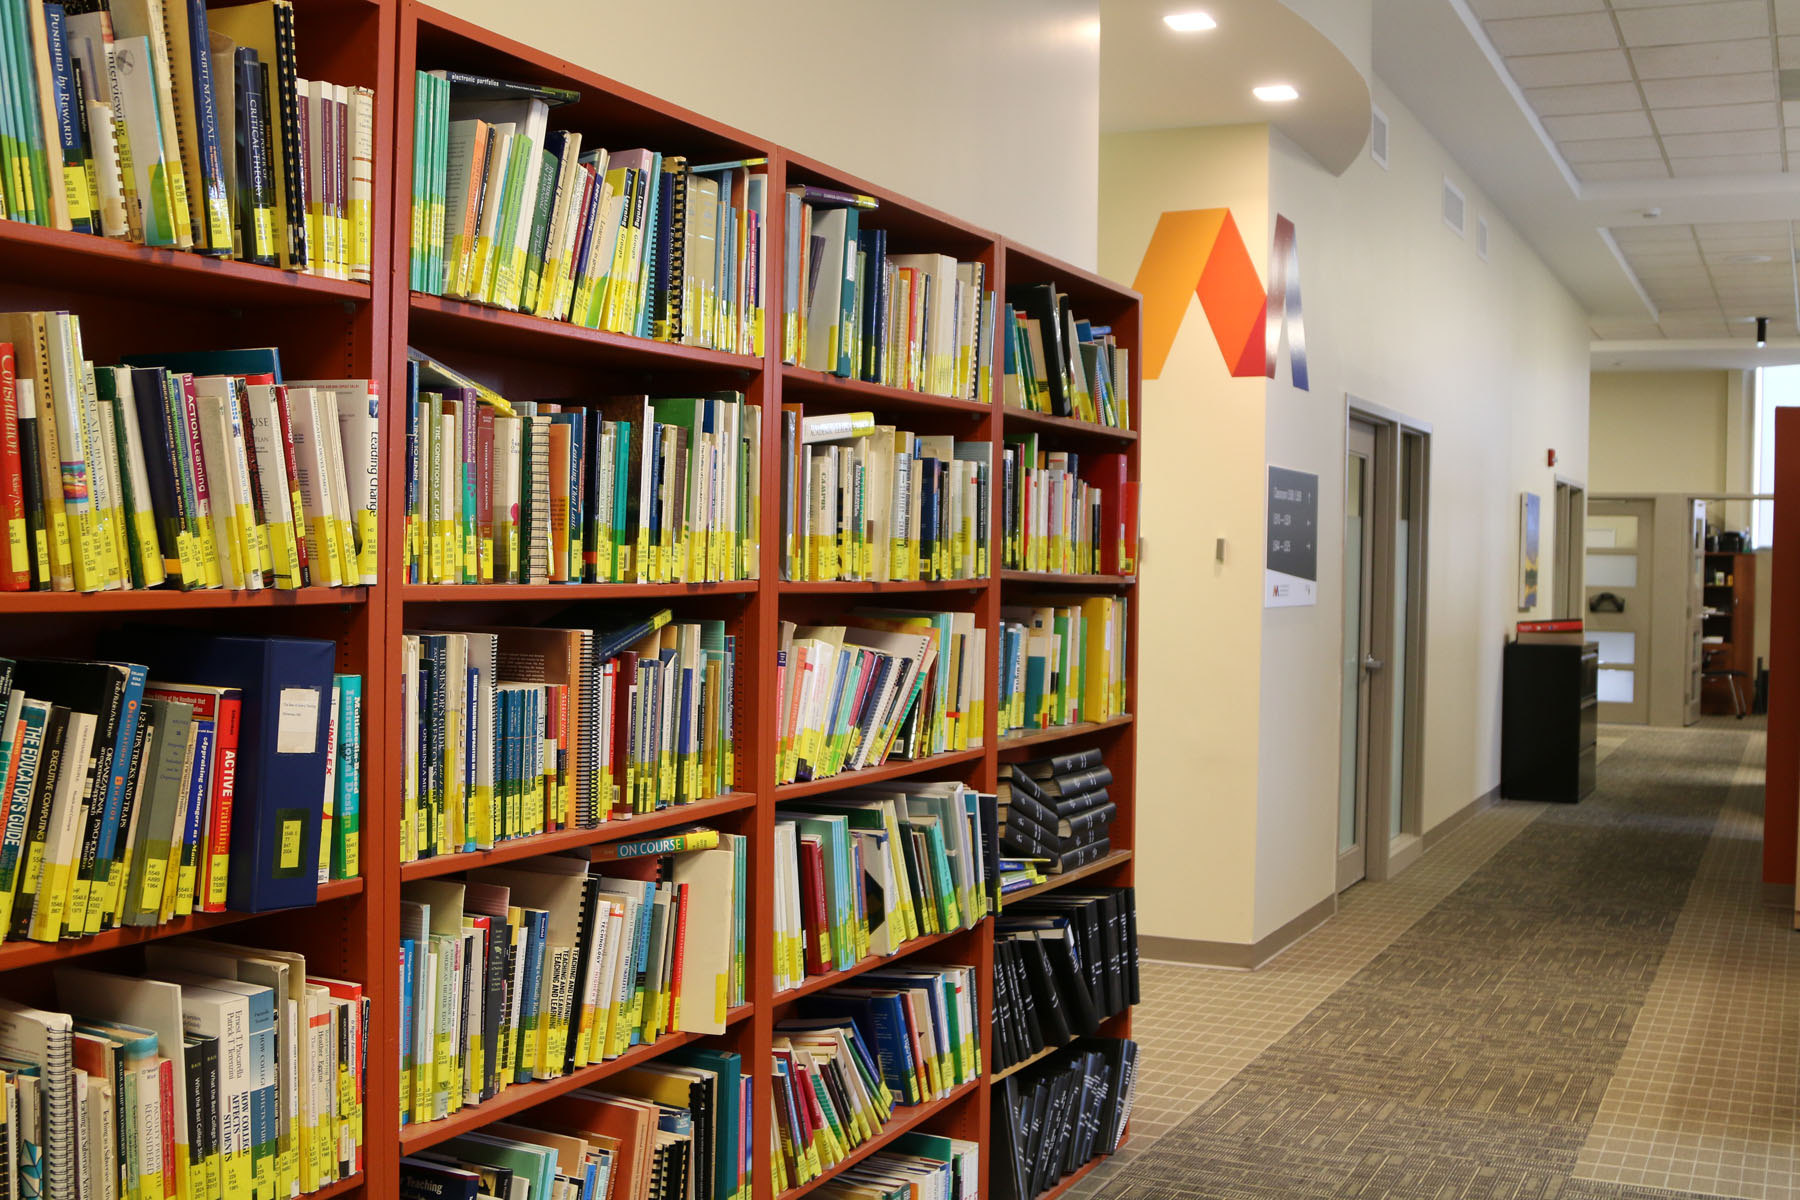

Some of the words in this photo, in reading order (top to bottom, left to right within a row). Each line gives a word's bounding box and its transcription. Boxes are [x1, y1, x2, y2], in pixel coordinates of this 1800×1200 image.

[51, 14, 64, 71] PUNISHED
[57, 76, 68, 89] by
[200, 51, 209, 80] MBTI
[108, 52, 125, 136] interviewing
[203, 84, 215, 141] MANUAL
[60, 93, 73, 146] REWARDS
[250, 99, 258, 151] CRITICAL
[588, 202, 598, 231] learning
[621, 195, 631, 227] Learning
[635, 195, 644, 227] Learning
[631, 234, 639, 259] Groups
[38, 325, 52, 410] STATISTICS
[86, 373, 101, 444] RETREATS
[98, 475, 108, 503] WORK
[166, 416, 175, 448] MANAGERS
[171, 450, 179, 478] THROUGH
[187, 394, 199, 440] ACTION
[193, 442, 206, 492] Learning
[367, 432, 378, 474] Leading
[571, 442, 580, 482] Learning
[367, 477, 378, 517] Change
[571, 485, 579, 506] That
[26, 726, 43, 745] THE
[118, 700, 137, 767] ORGANIZATIONAL
[326, 719, 335, 776] SIMPLEX
[344, 689, 354, 777] Instructional
[353, 696, 361, 794] Multimedia-Based
[11, 747, 39, 813] EDUCATOR'S
[45, 750, 59, 791] EXECUTIVE
[197, 737, 209, 782] Appraising
[222, 750, 235, 797] ACTIVE
[95, 748, 113, 814] ORGANIZATIONAL
[109, 776, 124, 822] BEHAVIOR
[36, 793, 52, 840] COMPUTING
[120, 801, 131, 828] TRAPS
[193, 785, 204, 827] Managers
[342, 780, 354, 828] Design
[5, 814, 25, 846] GUIDE
[87, 819, 101, 870] PSYCHOLOGY
[216, 800, 232, 853] Training
[620, 845, 637, 857] ON
[640, 839, 681, 854] COURSE
[596, 921, 606, 963] TECHNOLOGY
[553, 953, 562, 981] TEACHING
[570, 949, 579, 978] TEACHING
[567, 980, 575, 993] AND
[227, 1012, 235, 1037] Patrick
[235, 1010, 243, 1032] Ernest
[549, 998, 558, 1029] LEARNING
[564, 995, 573, 1026] LEARNING
[228, 1048, 236, 1080] Terenzini
[233, 1094, 241, 1134] AFFECTS
[241, 1091, 249, 1113] HOW
[145, 1104, 155, 1176] RECONSIDERED
[194, 1124, 203, 1147] College
[209, 1117, 218, 1139] College
[224, 1115, 233, 1162] STUDENTS
[241, 1115, 250, 1156] COLLEGE
